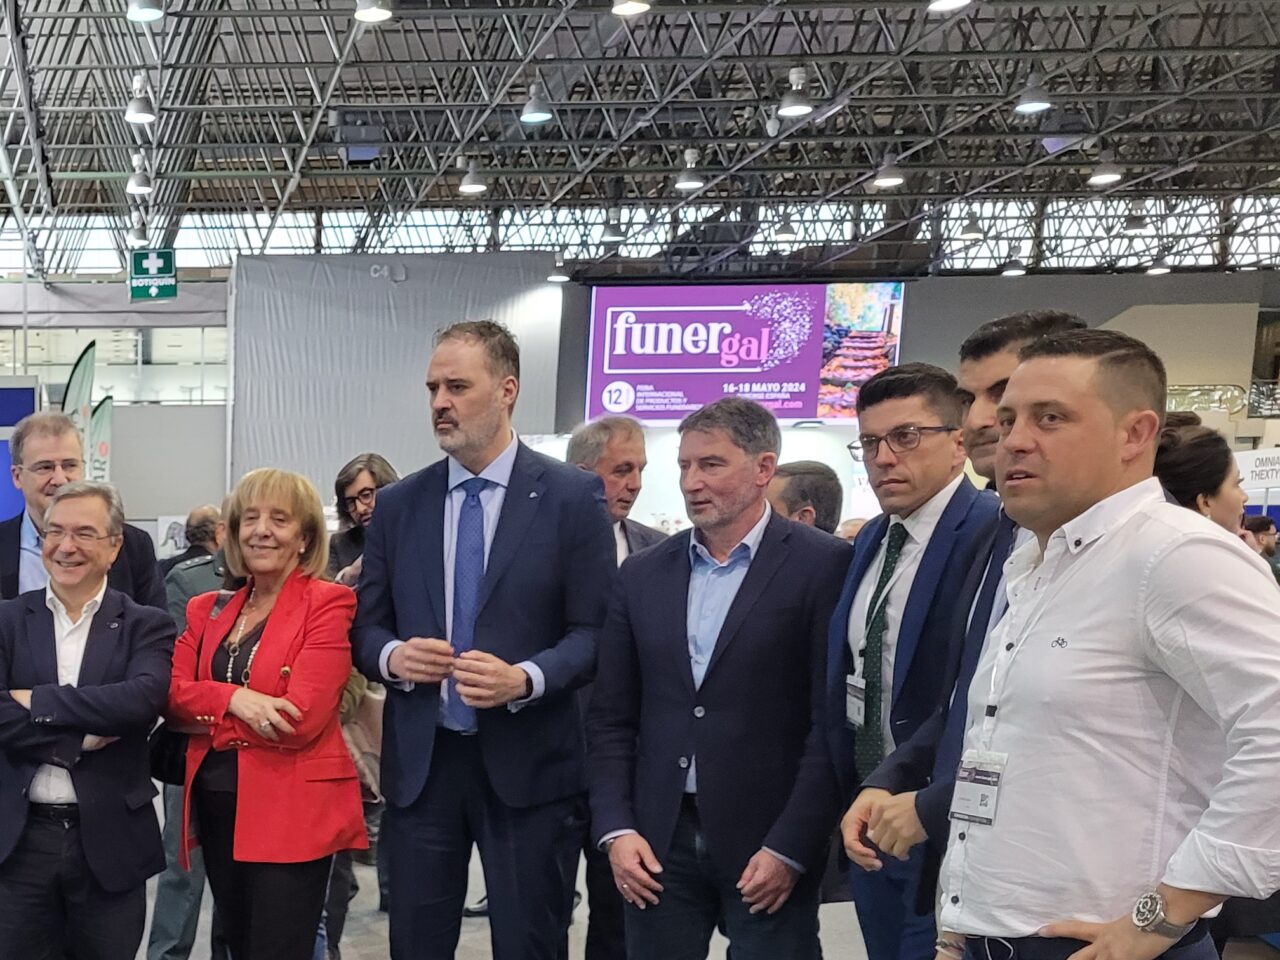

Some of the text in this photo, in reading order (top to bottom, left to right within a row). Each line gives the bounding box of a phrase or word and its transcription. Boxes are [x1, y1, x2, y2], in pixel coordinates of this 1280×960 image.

[751, 382, 781, 393] MAYO
[781, 382, 806, 392] 2024
[606, 388, 623, 405] 12
